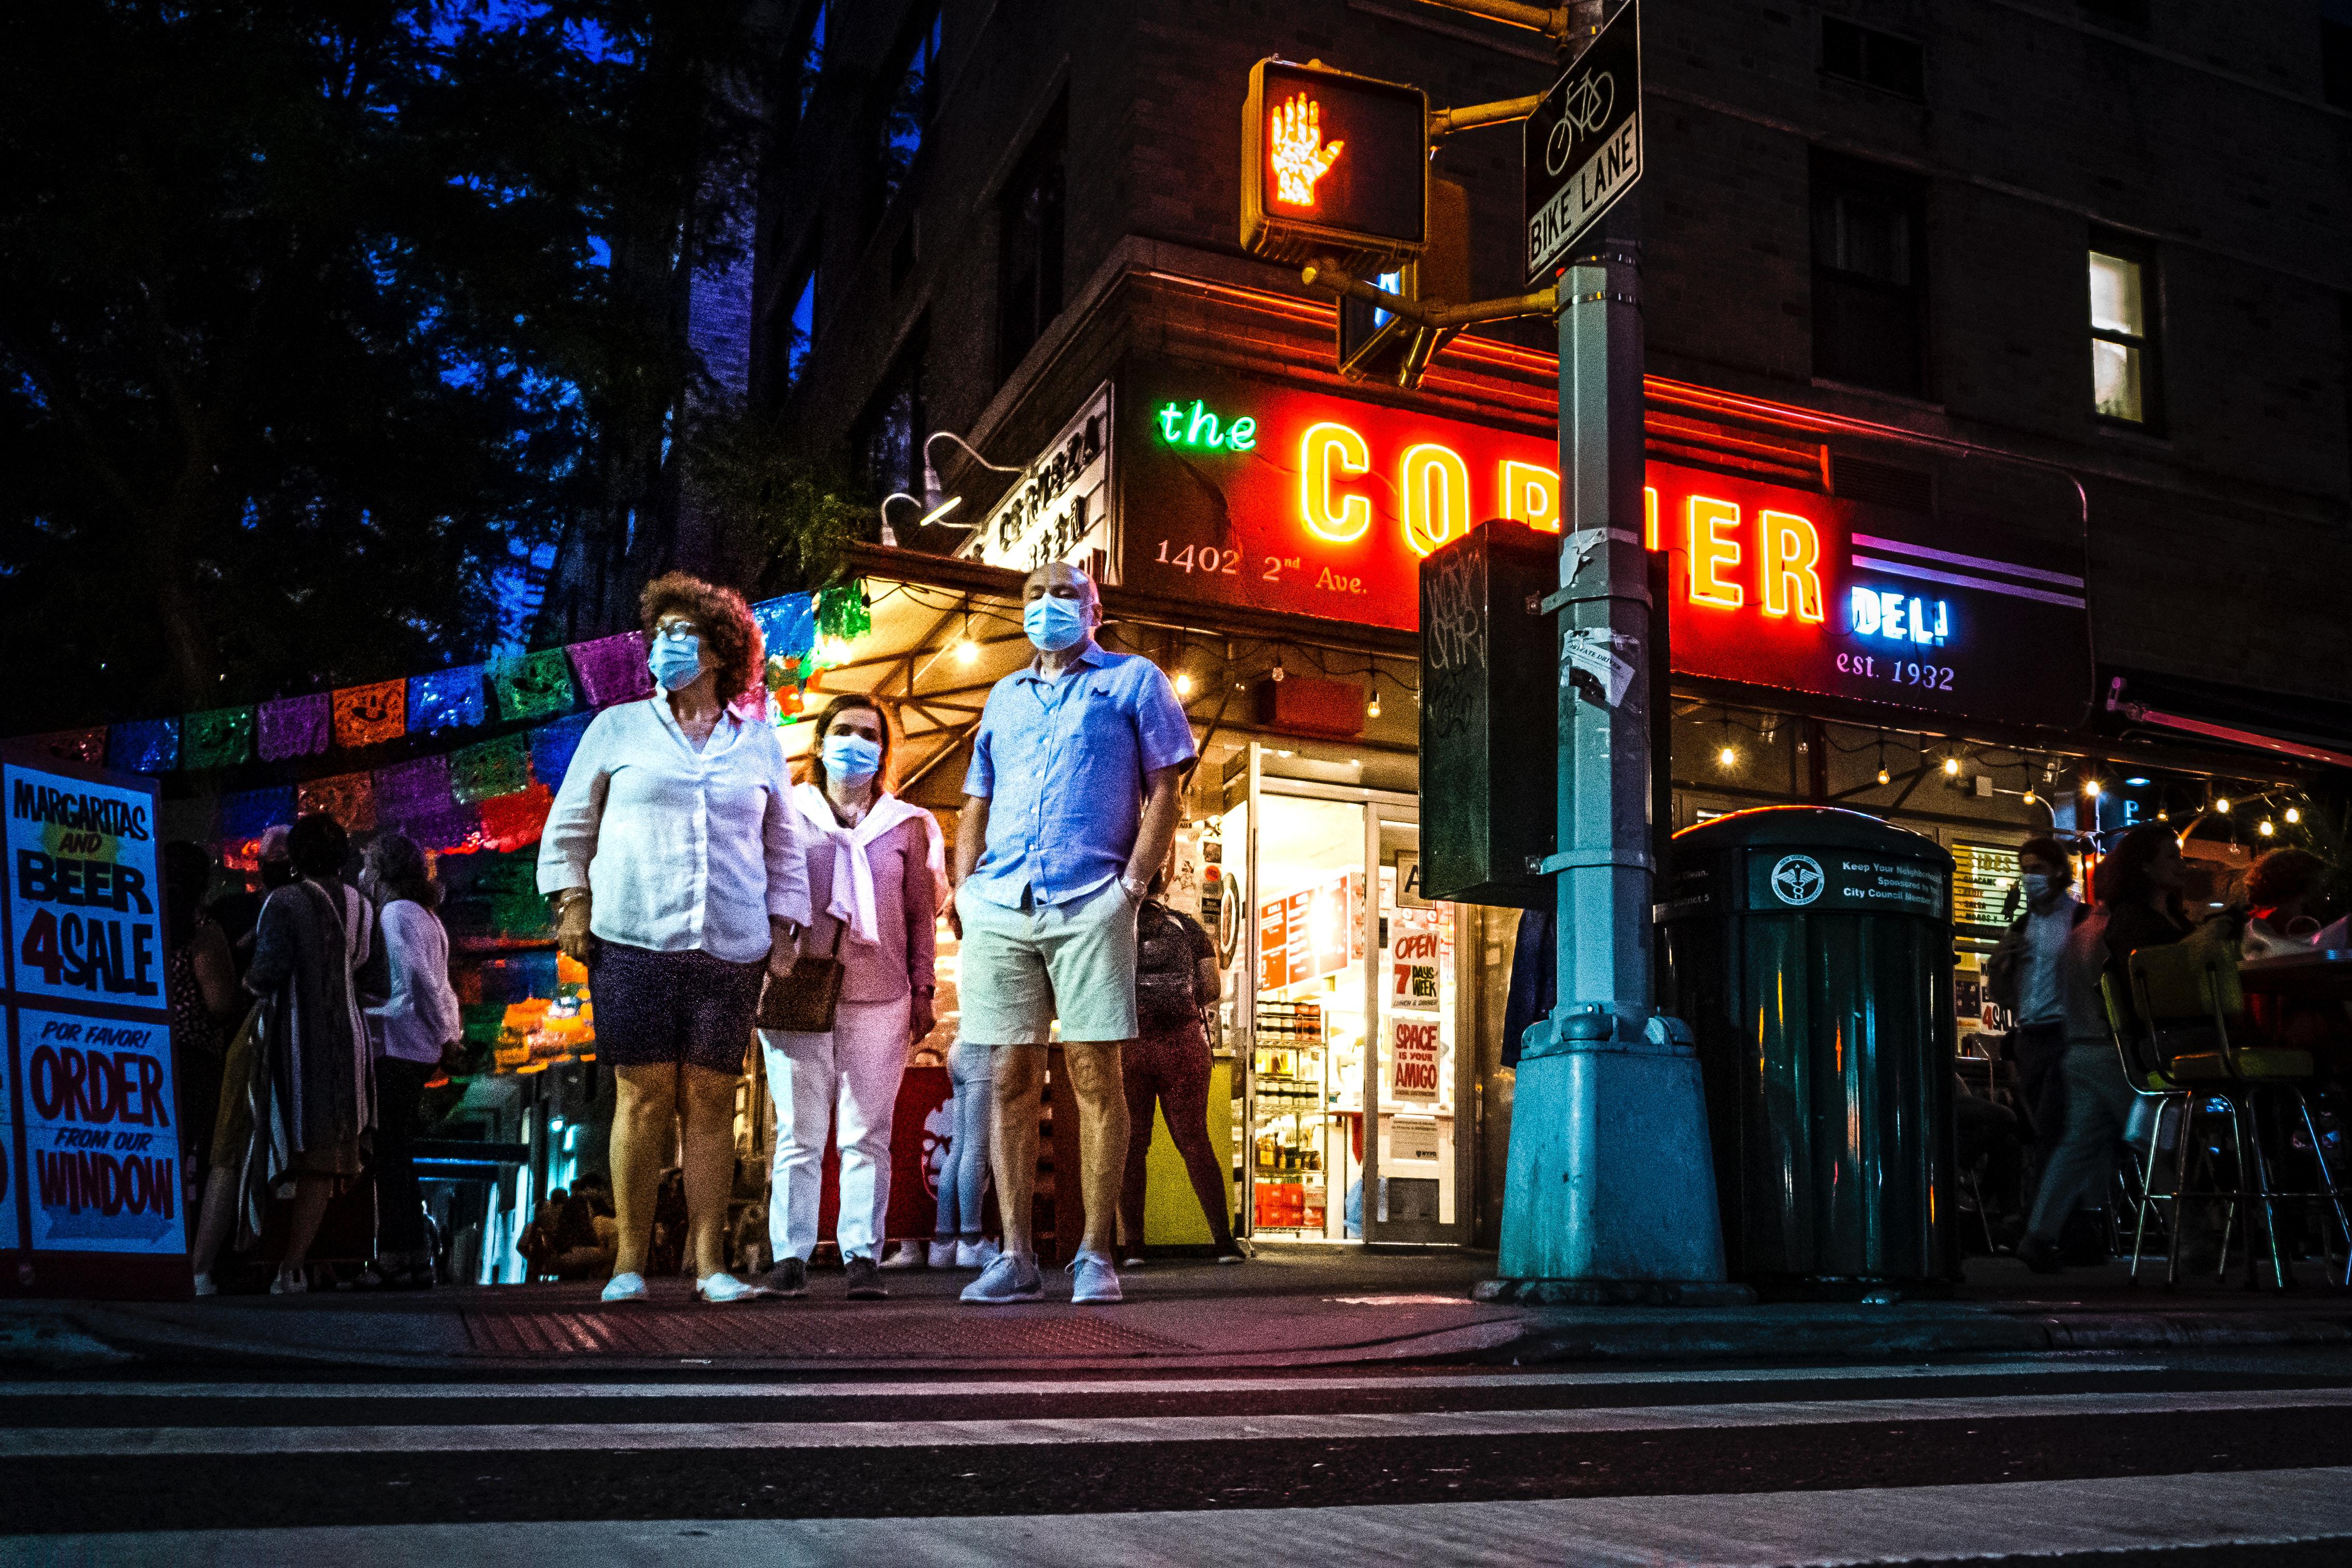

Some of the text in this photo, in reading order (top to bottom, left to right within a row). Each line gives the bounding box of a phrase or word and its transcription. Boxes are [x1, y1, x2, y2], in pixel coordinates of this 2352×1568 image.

[1531, 123, 1633, 260] BIKE LANE
[1160, 398, 1257, 451] the
[1298, 420, 1825, 623] CORER
[1156, 539, 1241, 575] 1402
[1262, 555, 1368, 596] 2nd Ave.
[1837, 653, 1955, 691] est. 1932
[15, 779, 149, 841] MARGARITAS
[58, 831, 102, 854] AND
[17, 848, 154, 914] BEER
[1842, 862, 1870, 872] Keep
[1873, 863, 1893, 873] Your
[1843, 887, 1865, 898] City
[1868, 888, 1903, 899] Council
[1395, 932, 1437, 959] OPEN
[1394, 964, 1411, 995] 7
[1412, 965, 1434, 980] DAYS
[1412, 977, 1437, 997] WEEK
[41, 1021, 152, 1049] POR FAVOR!
[1396, 1023, 1437, 1051] SPACE
[1398, 1051, 1433, 1062] IS YOUR
[30, 1044, 170, 1127] ORDER
[1395, 1062, 1437, 1090] AMIGO
[54, 1127, 153, 1152] FROM OUR
[36, 1148, 174, 1220] WINDOW
